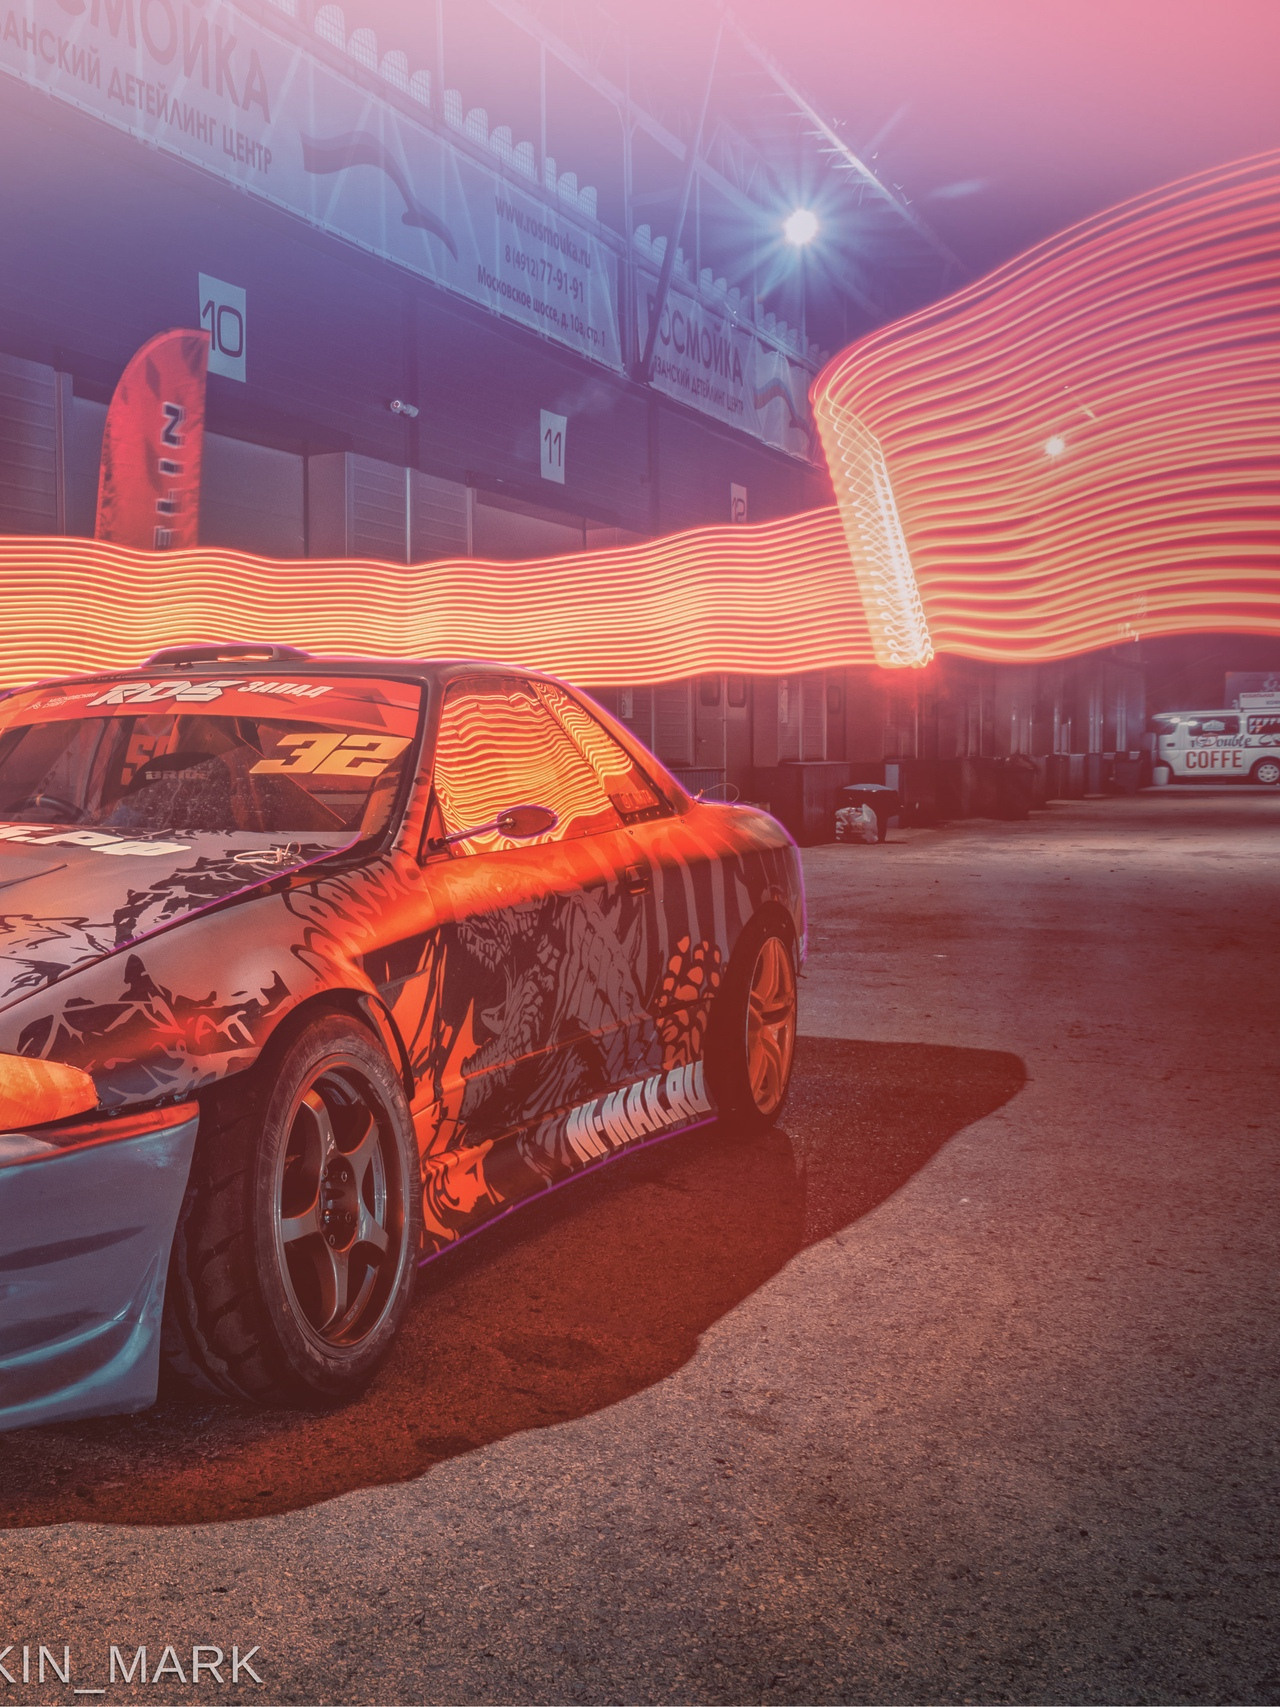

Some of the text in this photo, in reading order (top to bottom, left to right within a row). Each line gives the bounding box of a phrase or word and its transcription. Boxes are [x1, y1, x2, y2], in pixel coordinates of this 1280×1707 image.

[55, 0, 271, 124] МОЙКА
[107, 66, 217, 146] ДЕТЕЙЛИНГ
[223, 124, 272, 174] ЦЕНТР
[477, 264, 531, 310] Московское
[540, 258, 584, 303] 77-91-91
[202, 300, 244, 358] 10
[544, 428, 562, 467] 11
[86, 680, 248, 707] RDS
[238, 681, 334, 699] ЗАПАД
[249, 733, 413, 778] 32
[1186, 750, 1243, 768] COFFE
